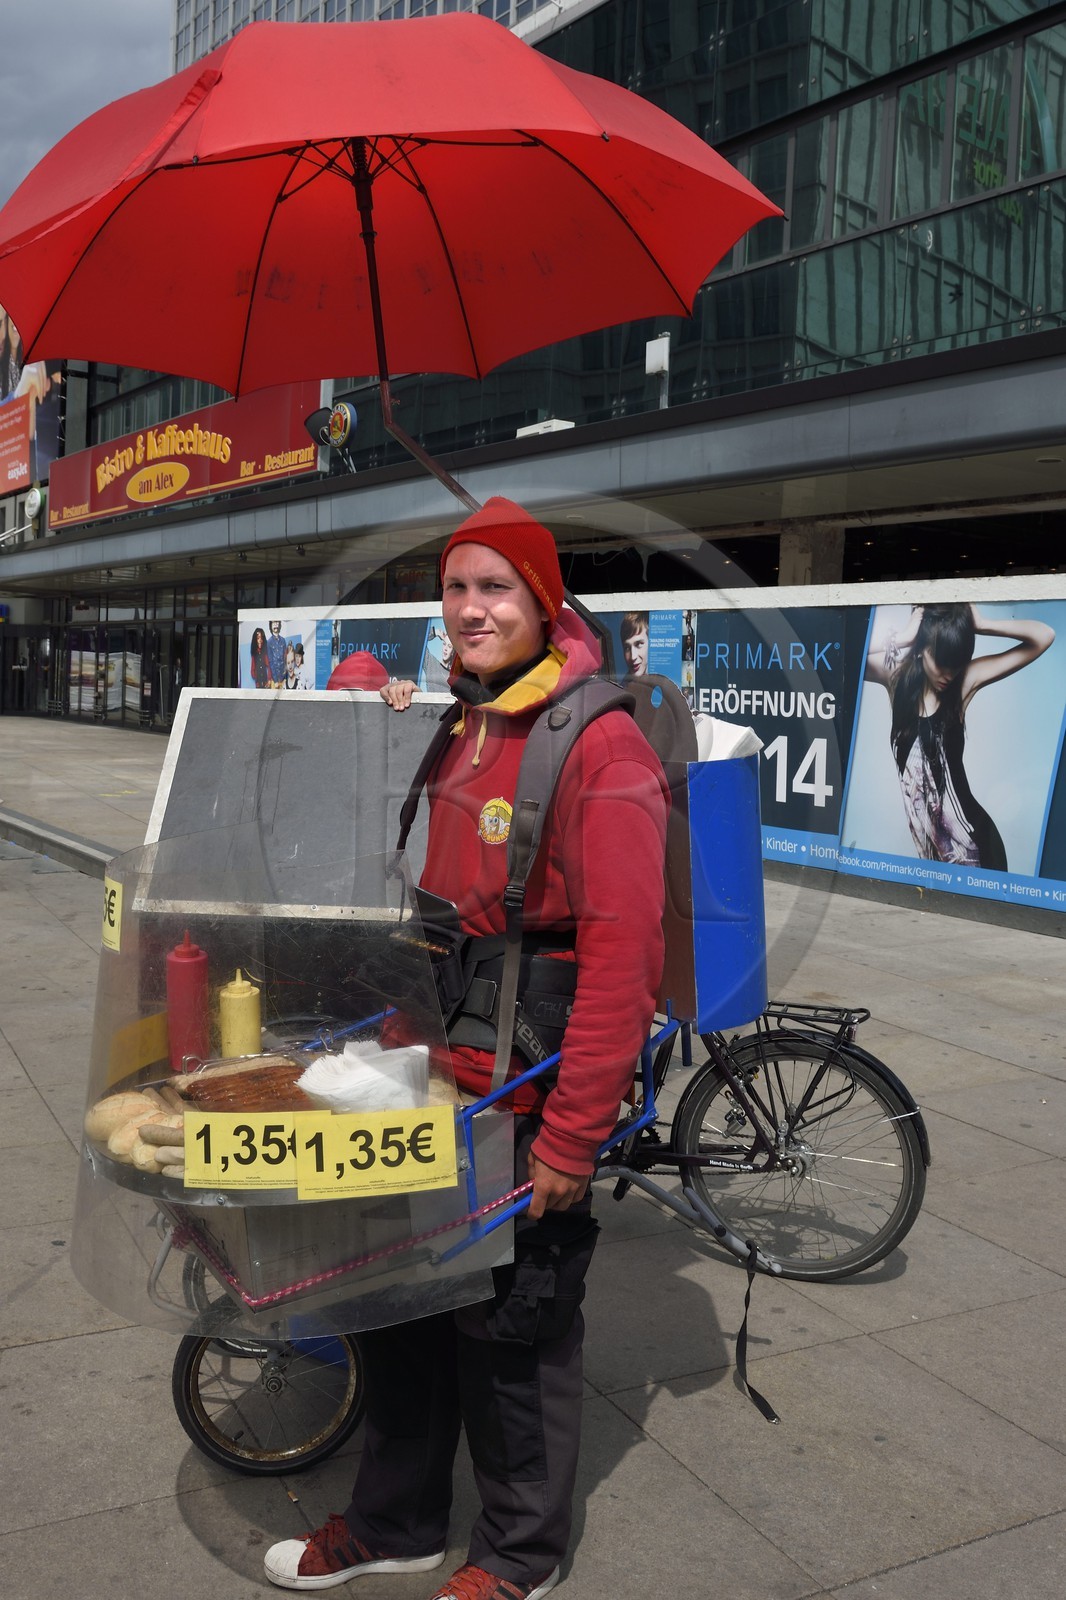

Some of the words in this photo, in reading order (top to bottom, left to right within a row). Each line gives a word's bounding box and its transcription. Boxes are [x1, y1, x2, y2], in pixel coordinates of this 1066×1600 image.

[96, 446, 134, 493] Bistro
[135, 434, 144, 463] &
[147, 422, 232, 464] Kaffeehaus
[240, 460, 256, 477] Bar
[264, 443, 315, 471] Restaurant
[138, 479, 152, 495] am
[154, 472, 174, 492] Alex
[50, 509, 58, 522] Bar
[63, 502, 90, 520] Restaurant
[698, 684, 836, 720] ERÖFFNUNG
[763, 735, 834, 808] 14
[766, 837, 798, 853] Kinder
[838, 854, 952, 884] ebook.com/Primark/Germany
[967, 876, 1000, 891] Damen
[1009, 883, 1042, 898] Herren
[195, 1123, 298, 1173] 1,35
[305, 1122, 436, 1180] 1,35€
